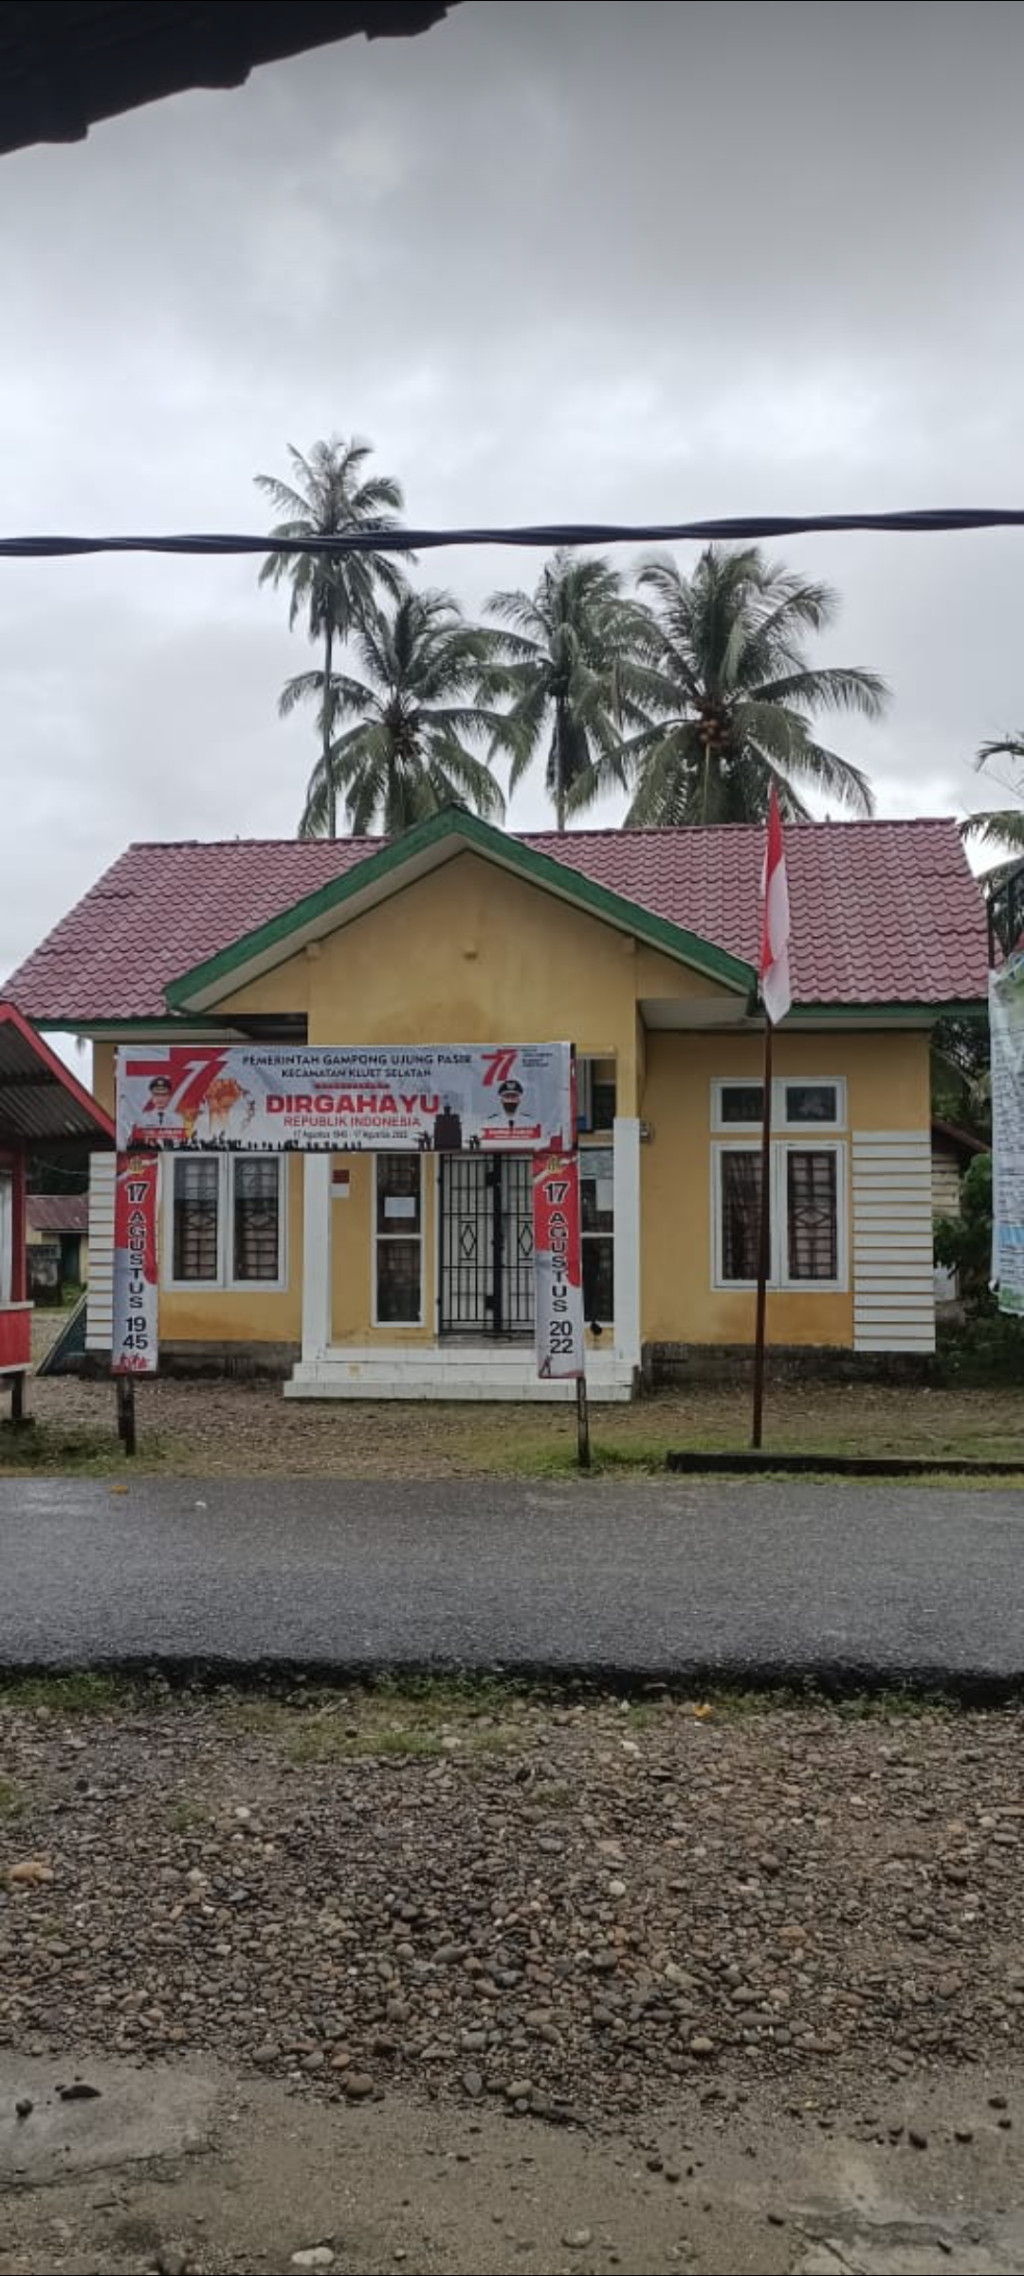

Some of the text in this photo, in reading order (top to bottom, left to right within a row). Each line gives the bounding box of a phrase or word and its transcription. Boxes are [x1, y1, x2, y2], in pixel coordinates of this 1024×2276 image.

[242, 1053, 472, 1066] PEMERINTAH GAMPONG UJUNG PASIR
[481, 1048, 517, 1087] 77
[281, 1068, 431, 1078] KECAMATAN KLUET SELATAN
[266, 1093, 440, 1114] DIRGAHAYU
[283, 1115, 422, 1127] REPUBLIK INDONESIA
[126, 1182, 149, 1202] 17
[544, 1182, 569, 1202] 17
[129, 1210, 145, 1309] AGUSTUS
[550, 1212, 567, 1312] AGUSTUS
[125, 1316, 147, 1332] 19
[549, 1320, 573, 1336] 20
[122, 1333, 149, 1350] 45
[549, 1338, 574, 1354] 22
